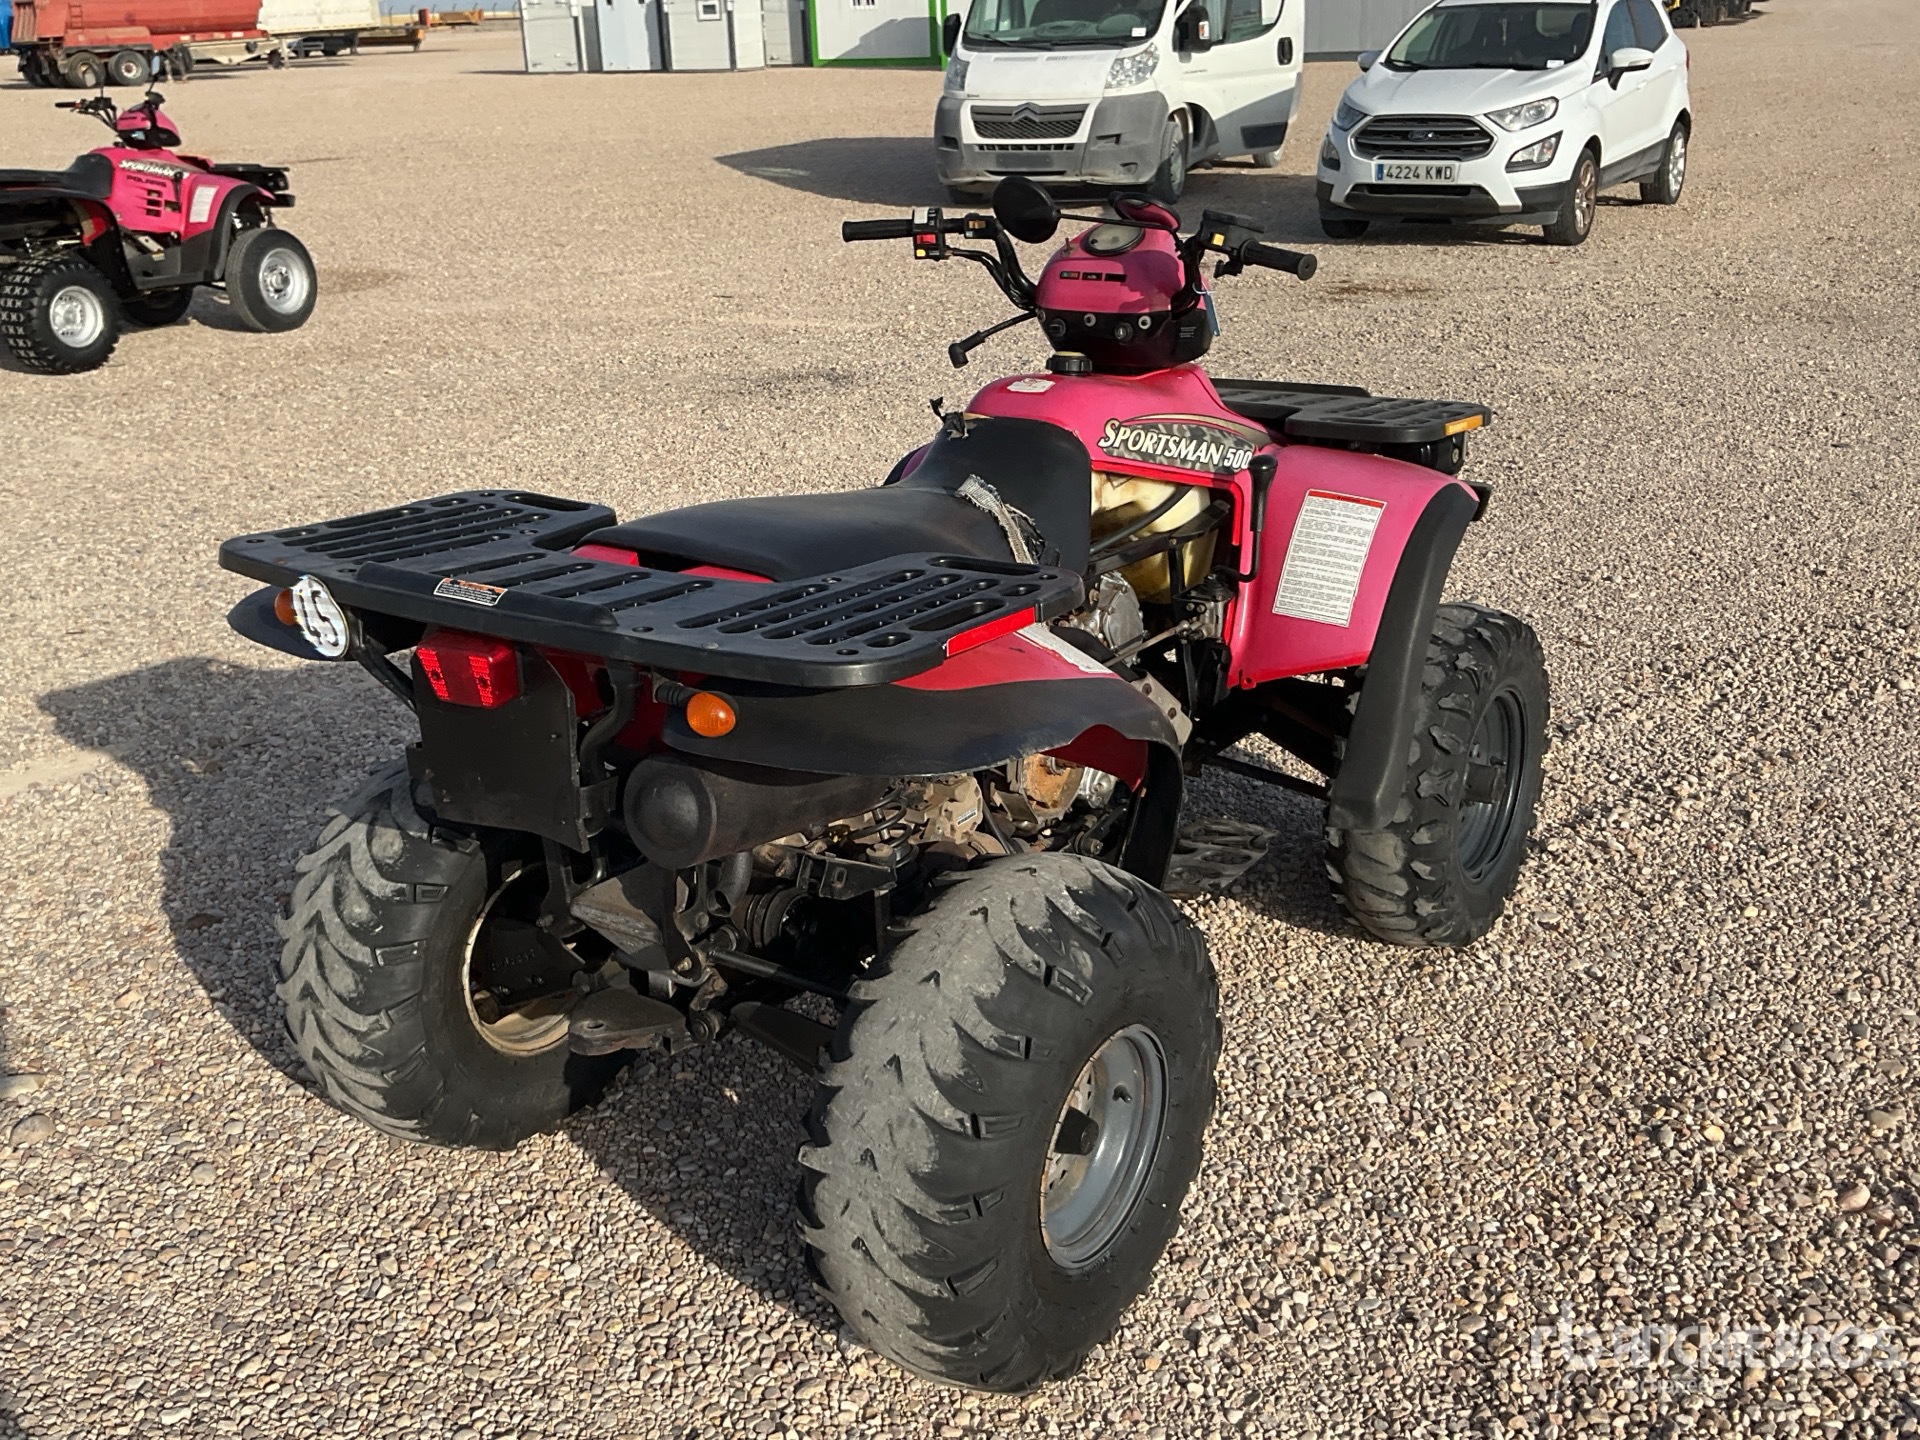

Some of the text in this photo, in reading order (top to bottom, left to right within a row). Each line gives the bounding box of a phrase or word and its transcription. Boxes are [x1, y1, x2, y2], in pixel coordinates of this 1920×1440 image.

[119, 160, 175, 177] SPORTSMAN
[1386, 166, 1452, 180] 4224 KWD
[126, 175, 167, 187] POLARIS
[1098, 418, 1253, 470] SPORTSMAN 500
